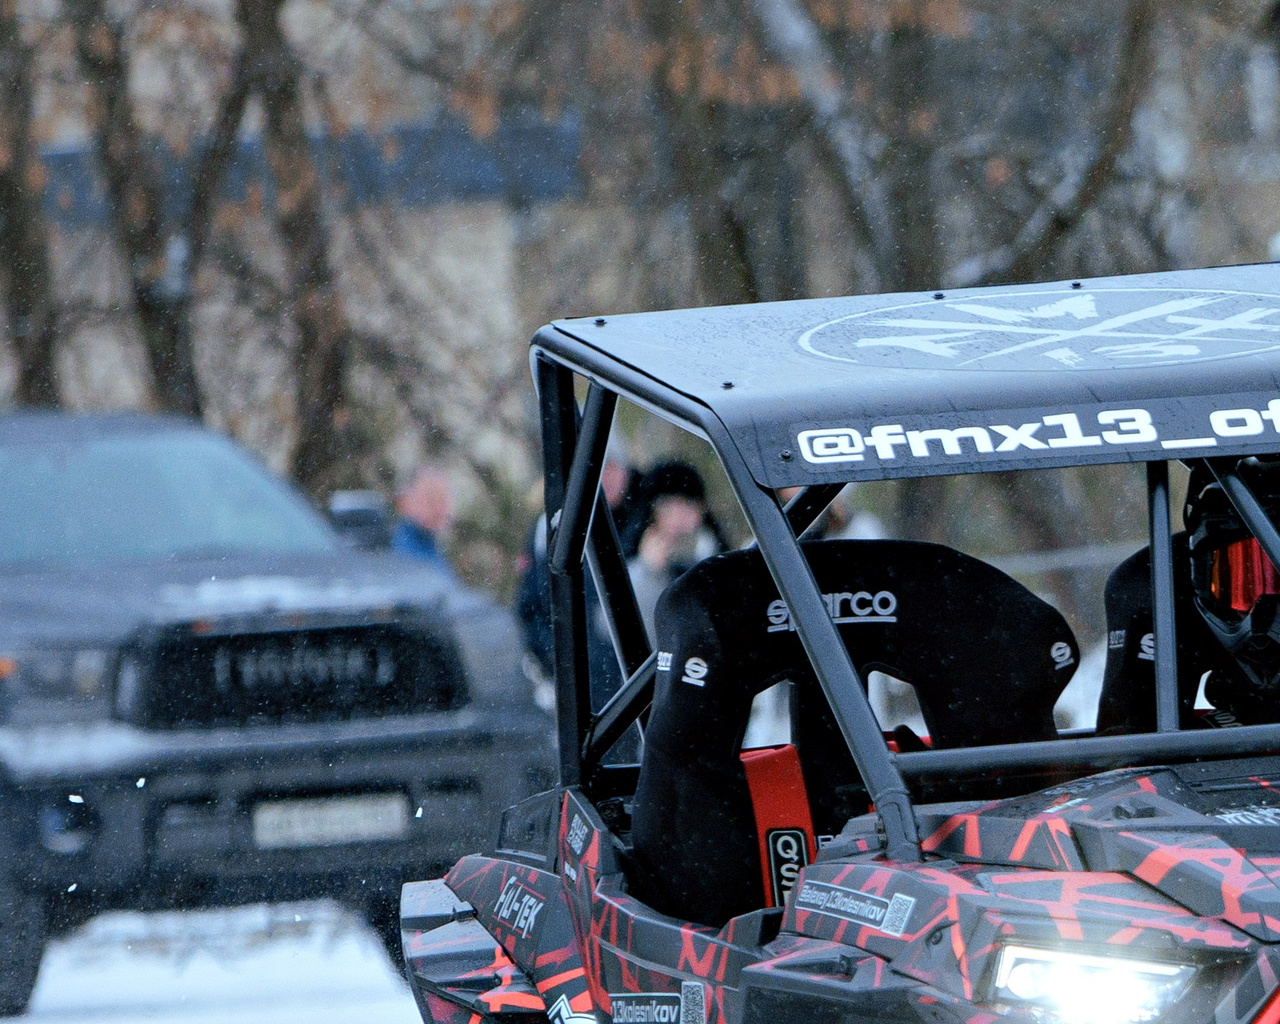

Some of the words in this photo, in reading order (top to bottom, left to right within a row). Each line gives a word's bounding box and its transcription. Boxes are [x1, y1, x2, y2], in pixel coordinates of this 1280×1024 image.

[767, 590, 897, 632] sarco
[776, 835, 800, 905] QS
[611, 1000, 679, 1023] 13kolesnikov
